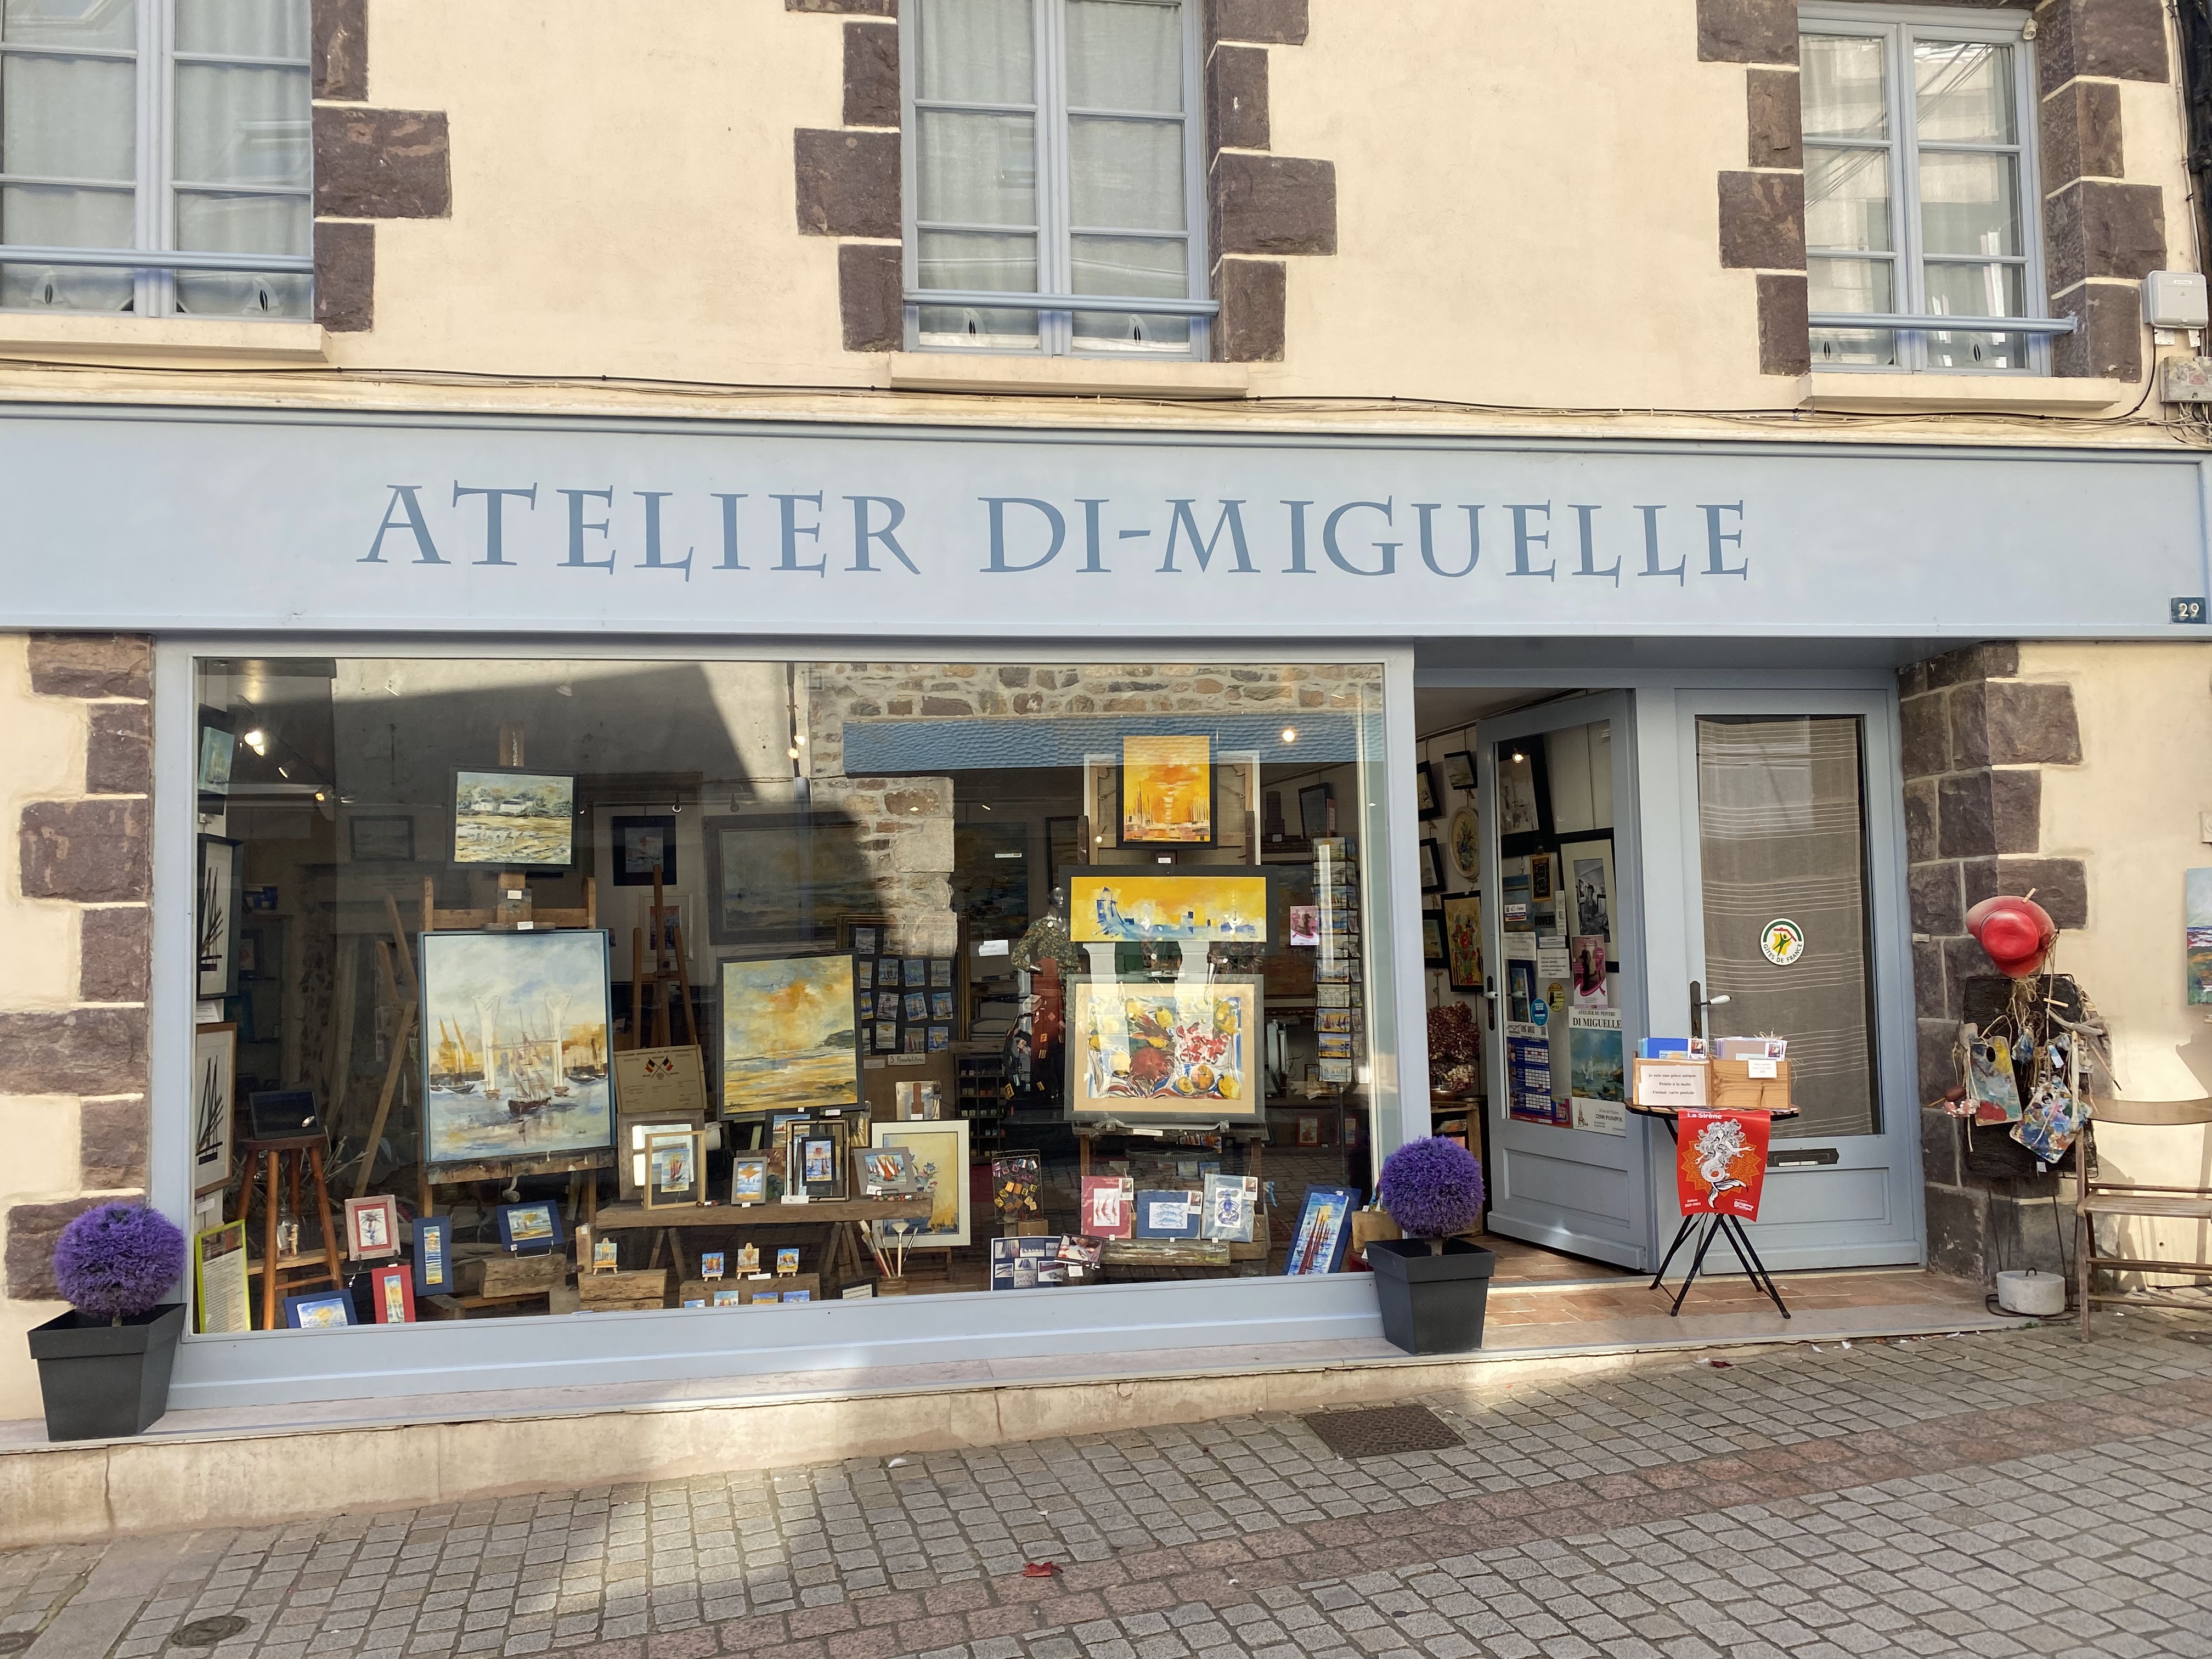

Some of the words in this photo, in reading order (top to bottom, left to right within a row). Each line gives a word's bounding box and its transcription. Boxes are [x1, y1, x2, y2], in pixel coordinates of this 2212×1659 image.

[356, 479, 921, 582] ATELIER
[977, 494, 1749, 588] DI-MIGUELLE
[2178, 602, 2199, 618] 29
[1763, 944, 1775, 960] GÎTES
[1786, 943, 1803, 963] FRANCE
[1573, 1017, 1581, 1026] DI
[1583, 1018, 1622, 1029] MIGUELLE
